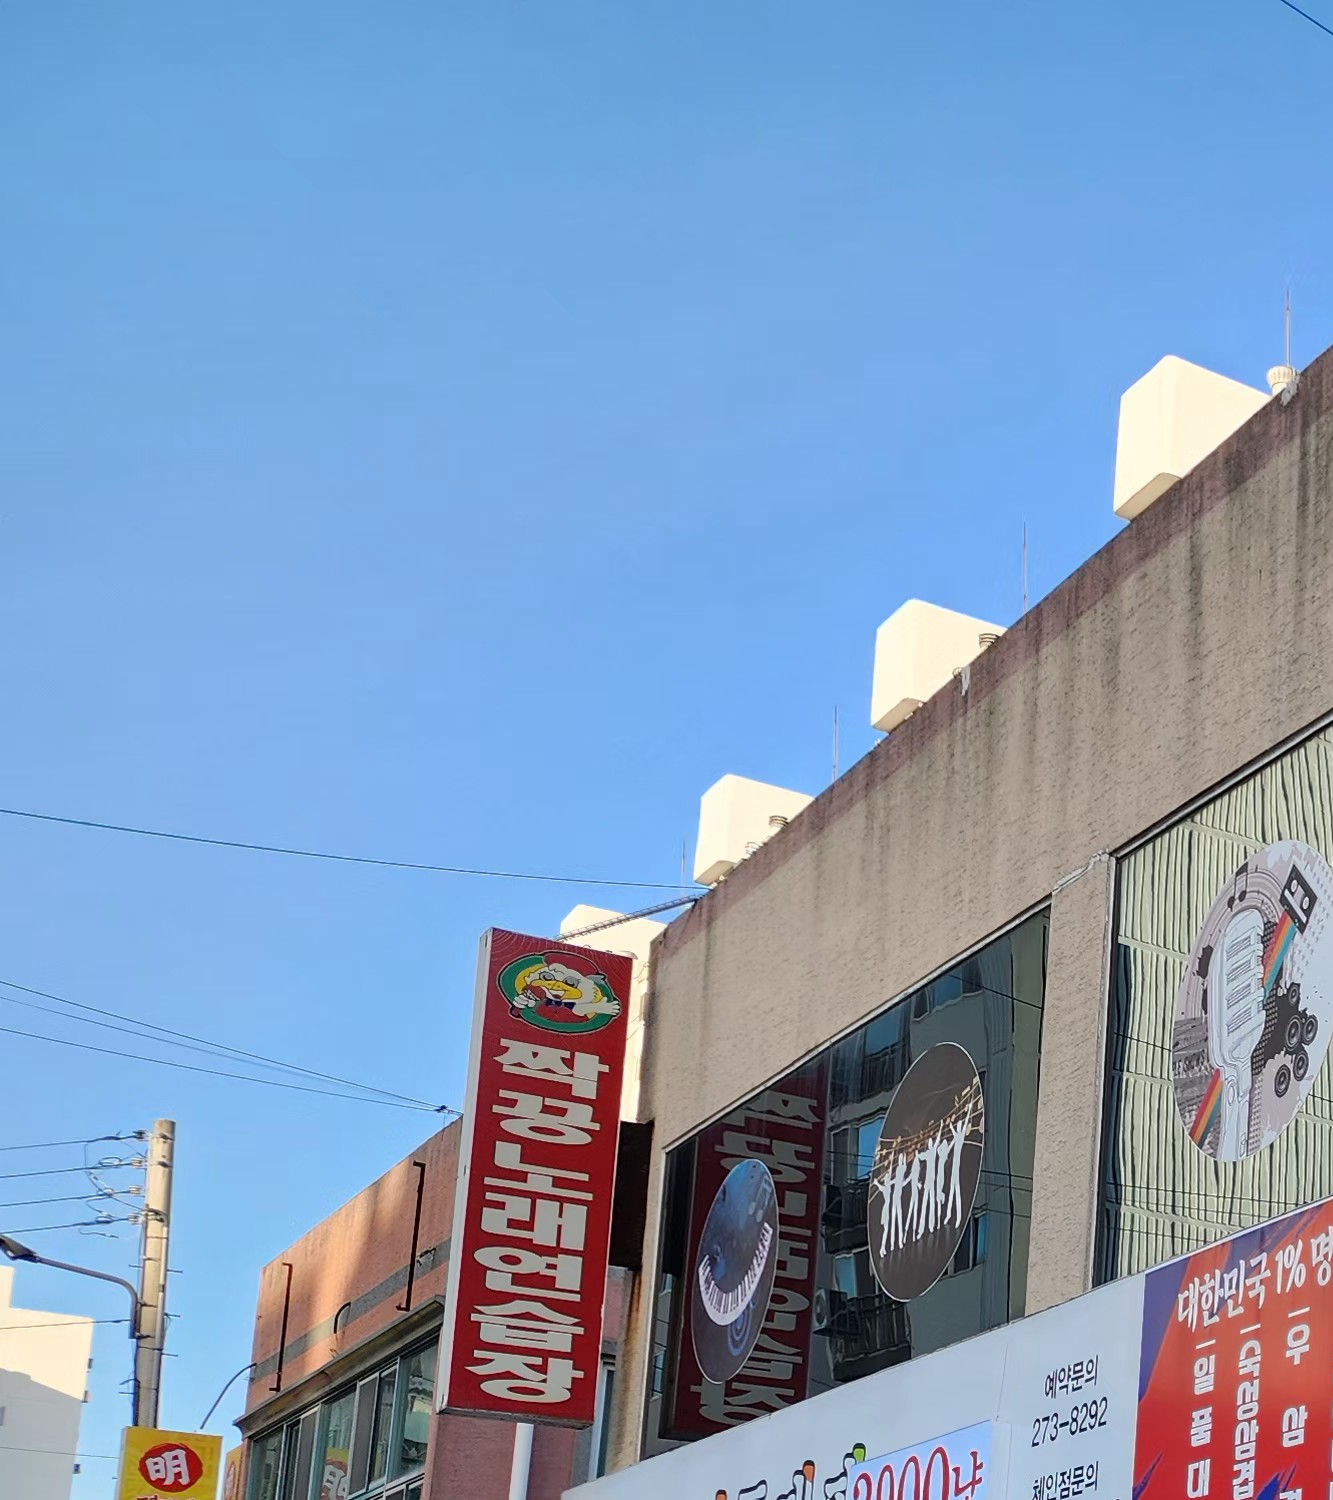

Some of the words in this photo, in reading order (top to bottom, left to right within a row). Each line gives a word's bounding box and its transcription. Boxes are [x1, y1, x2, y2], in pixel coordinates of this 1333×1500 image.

[463, 1036, 610, 1404] 짝꿍노래연습장
[1177, 1251, 1273, 1333] 대한민국
[1275, 1239, 1306, 1294] 1%
[1044, 1353, 1099, 1399] 예약문의
[1031, 1396, 1108, 1449] 273-8292
[145, 1448, 191, 1487] 明
